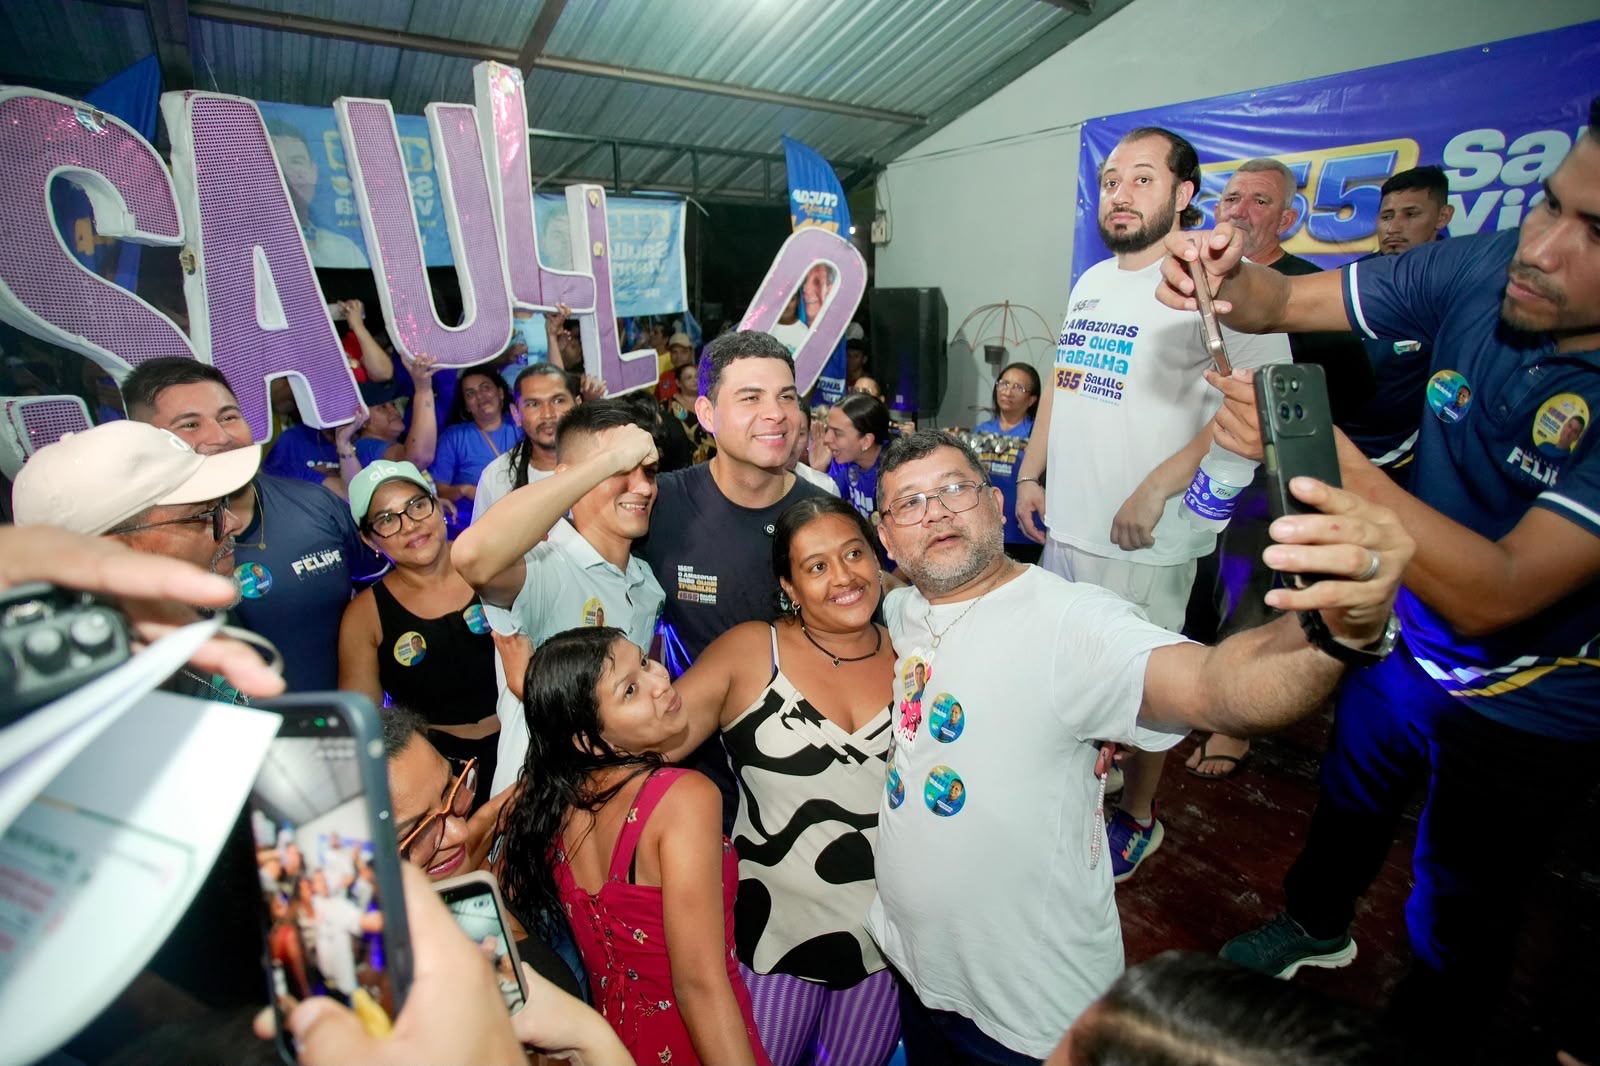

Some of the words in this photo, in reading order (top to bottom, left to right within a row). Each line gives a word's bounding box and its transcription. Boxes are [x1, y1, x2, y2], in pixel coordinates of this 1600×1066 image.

[1443, 126, 1589, 192] Sa
[1447, 188, 1546, 238] Vi
[291, 550, 342, 575] FELIPE
